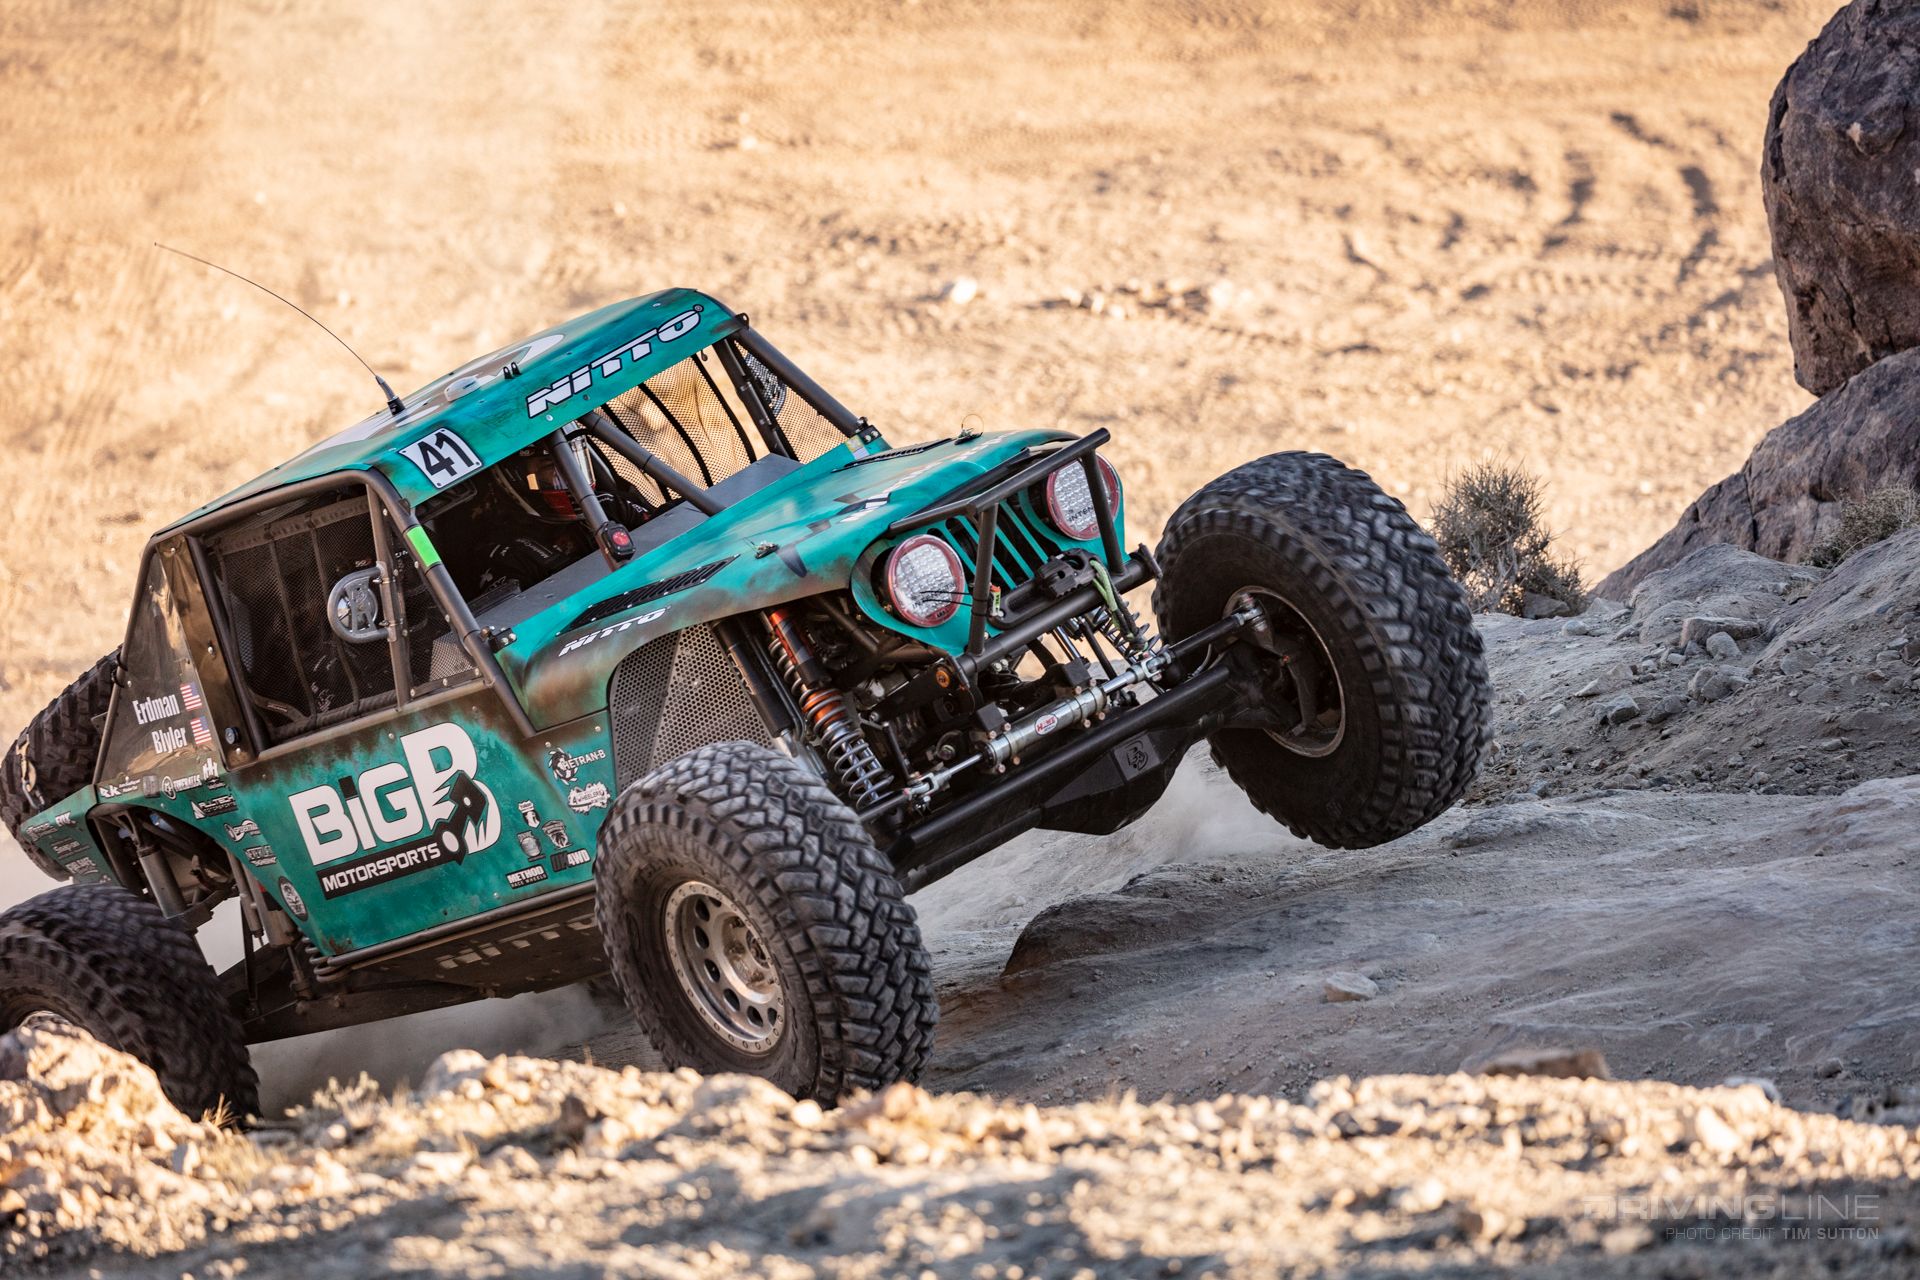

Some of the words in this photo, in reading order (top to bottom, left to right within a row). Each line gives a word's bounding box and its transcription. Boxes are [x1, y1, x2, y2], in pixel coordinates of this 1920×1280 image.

[526, 305, 702, 418] NITTO
[416, 430, 473, 477] 41
[558, 607, 667, 657] NITTO
[132, 693, 181, 725] Erdman
[151, 727, 188, 755] Blyler
[321, 842, 441, 893] MOTORSPORTS
[507, 865, 545, 883] METHOD
